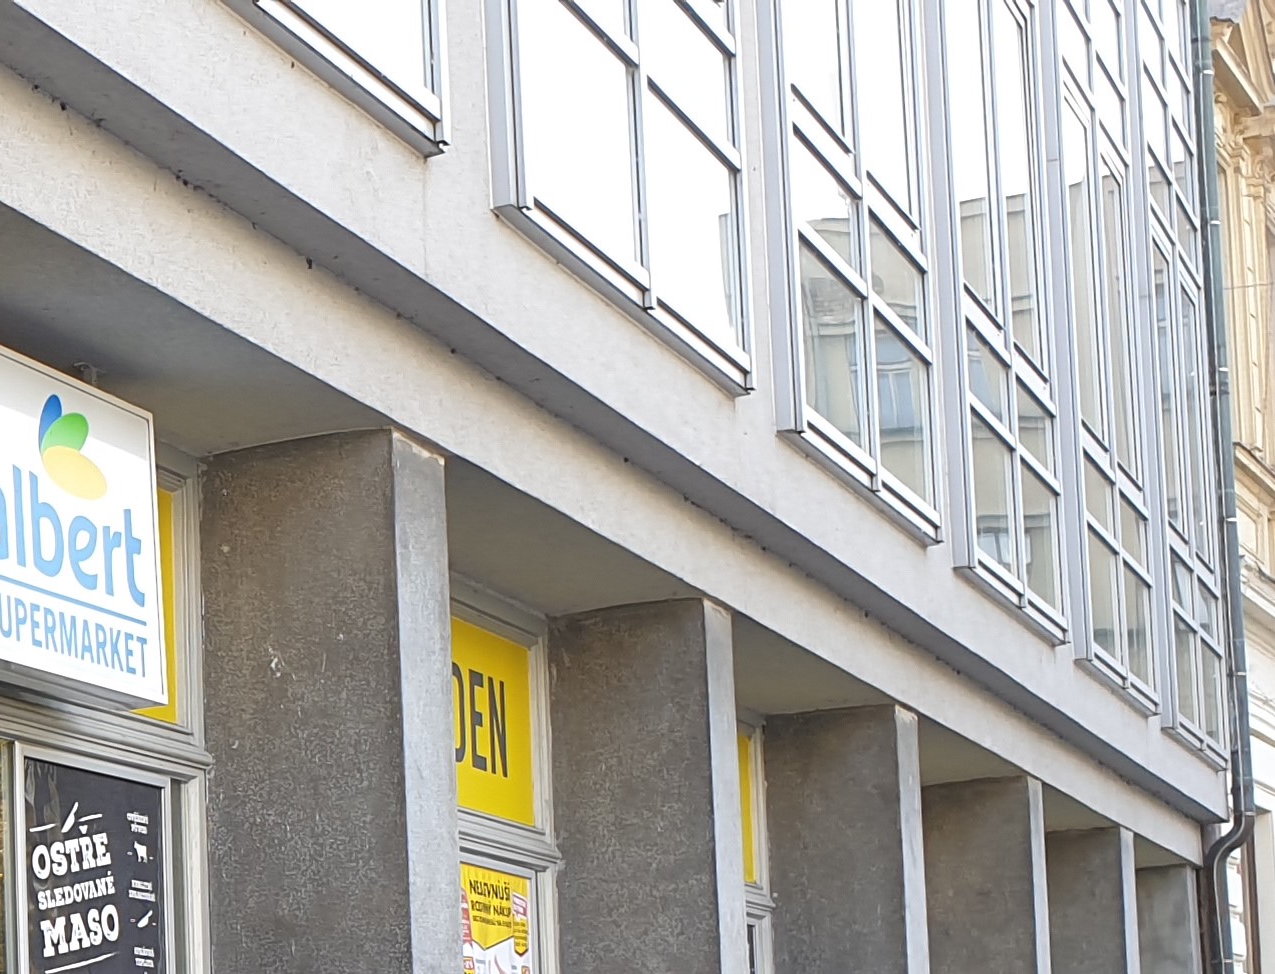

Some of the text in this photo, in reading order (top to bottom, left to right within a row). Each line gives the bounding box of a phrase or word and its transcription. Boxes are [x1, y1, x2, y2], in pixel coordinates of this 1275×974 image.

[32, 825, 112, 880] OSTŘE
[37, 870, 116, 911] SLEDOVANÉ
[39, 904, 120, 958] MASO
